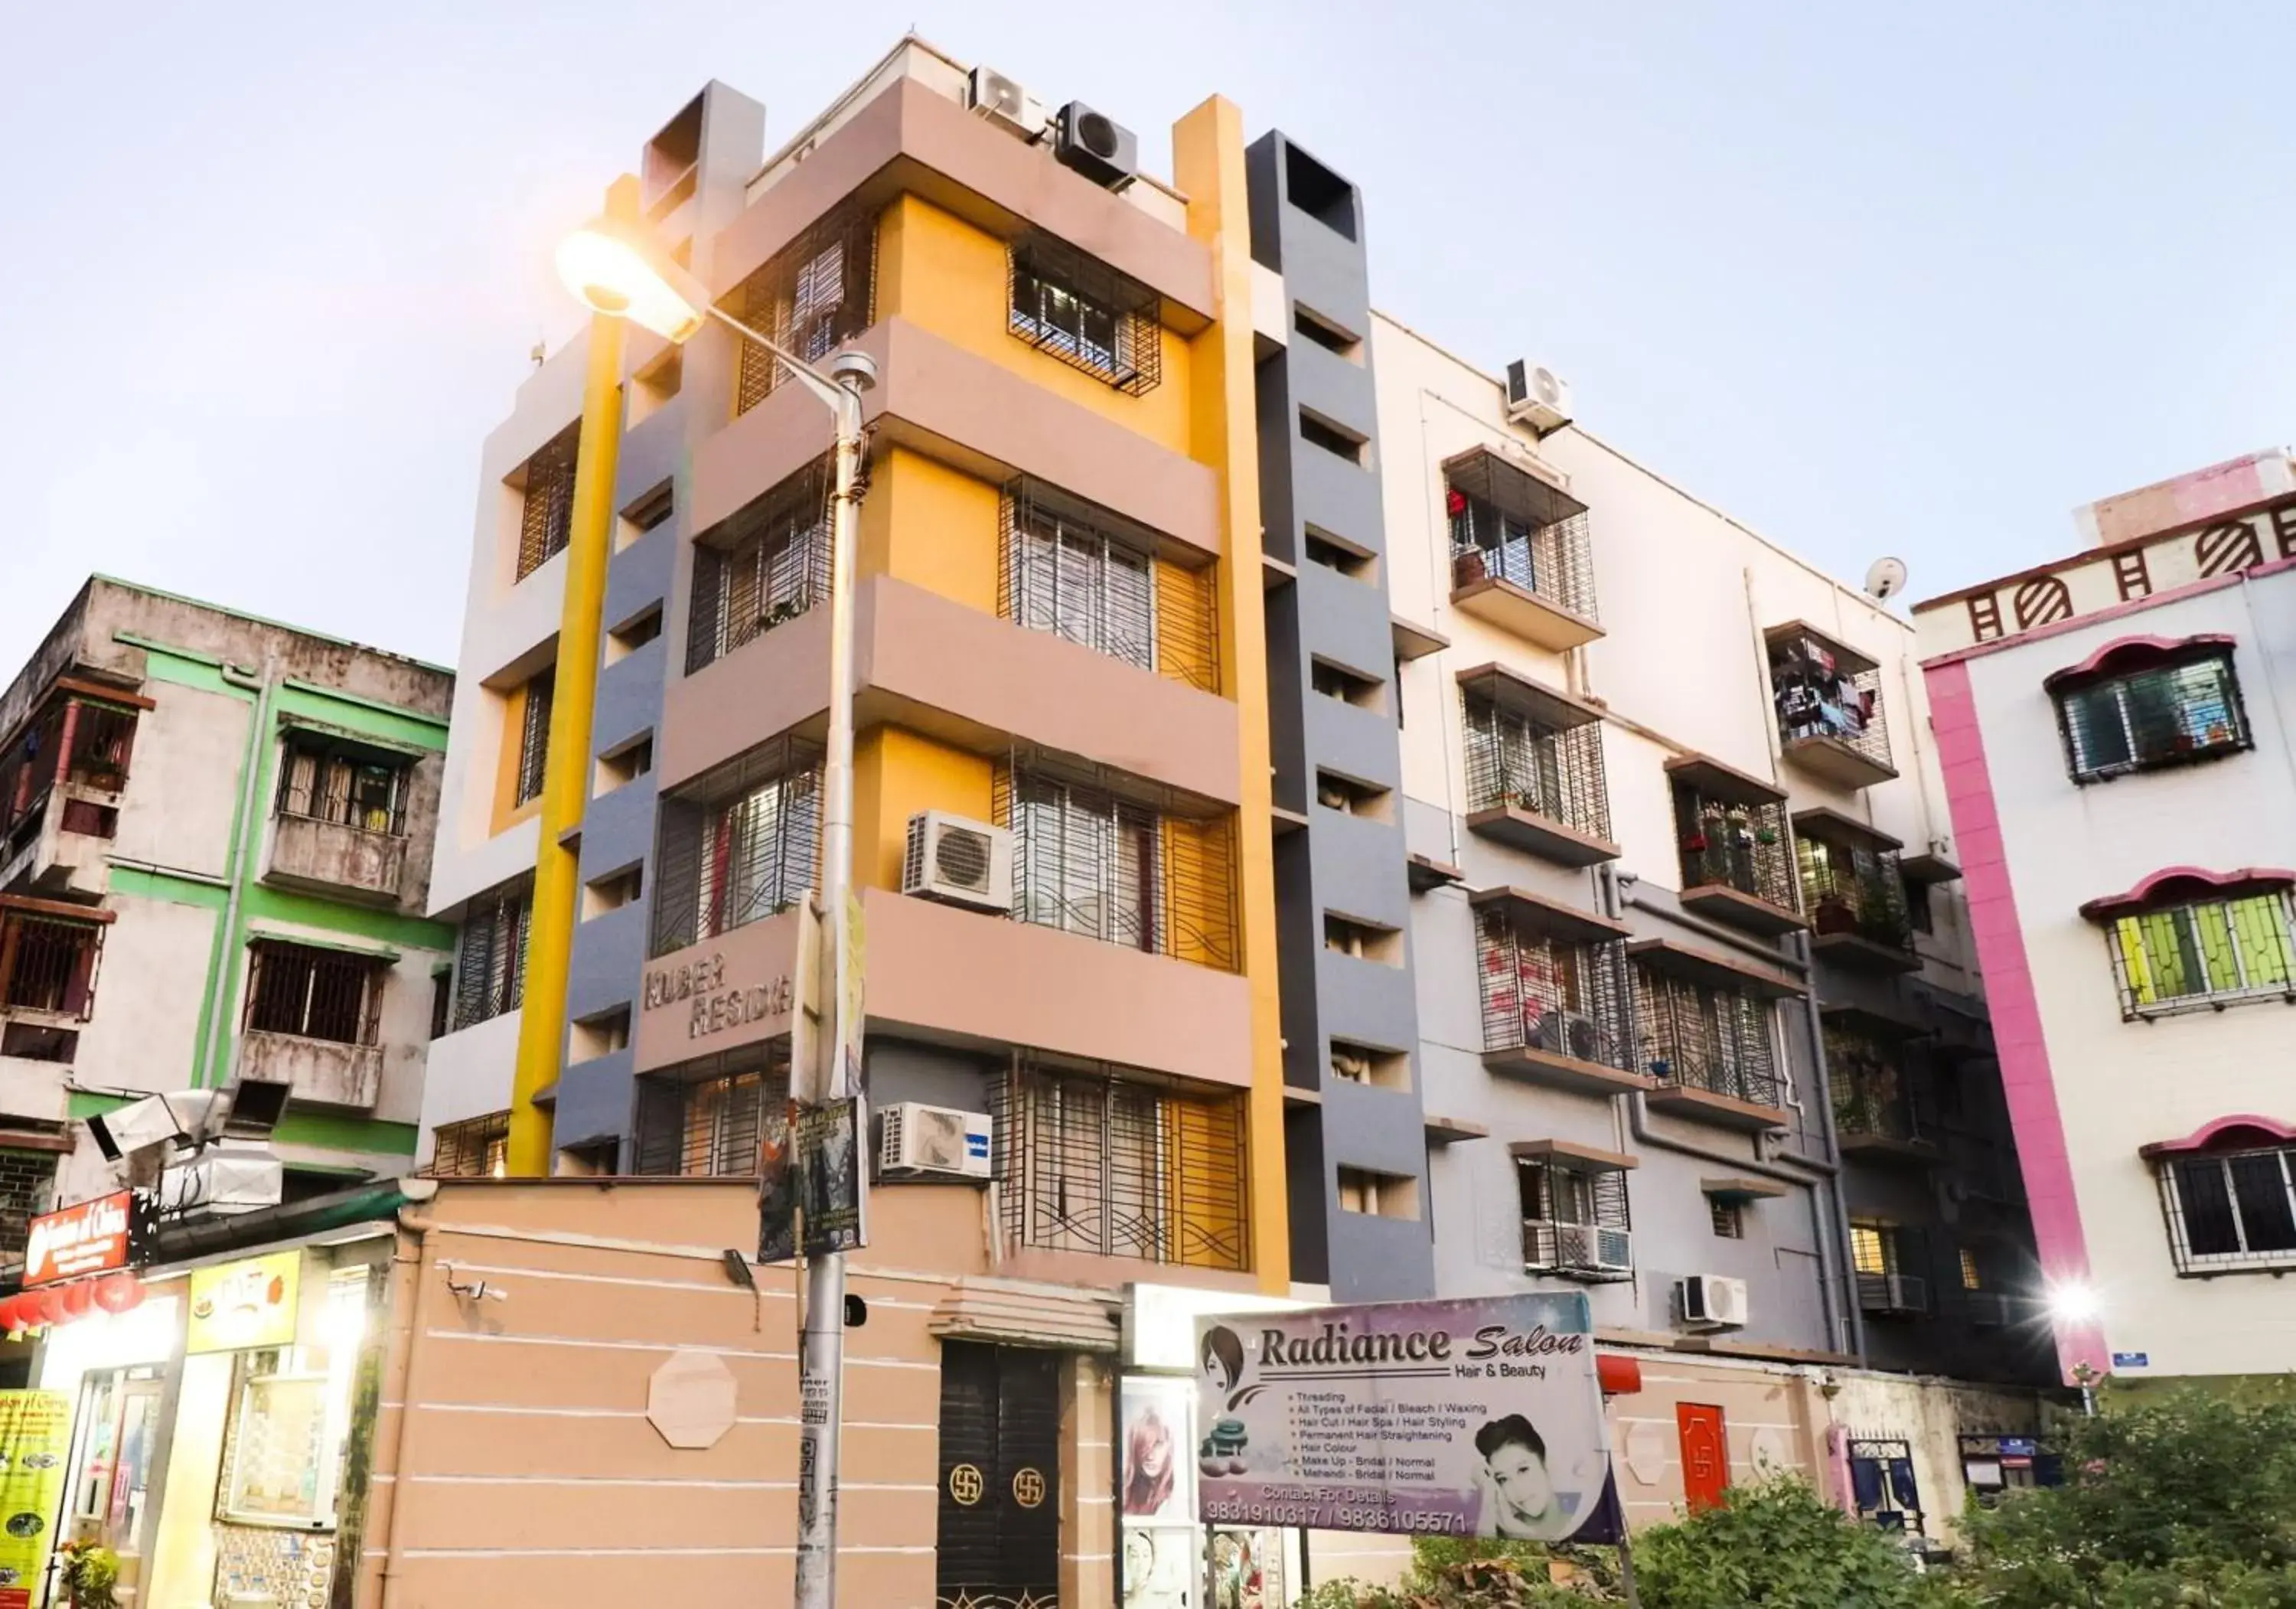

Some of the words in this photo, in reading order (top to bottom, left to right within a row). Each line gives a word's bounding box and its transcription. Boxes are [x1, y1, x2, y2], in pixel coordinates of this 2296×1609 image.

[644, 953, 726, 1010] KUBER
[690, 974, 795, 1039] RESIDE
[1258, 1323, 1451, 1366] Radiance
[1466, 1324, 1583, 1359] Salon
[1455, 1364, 1482, 1378] Hair
[1486, 1363, 1496, 1377] &
[1500, 1363, 1545, 1381] Beauty
[1296, 1392, 1345, 1403] Threading
[1297, 1405, 1309, 1414] All
[1313, 1405, 1342, 1416] Types
[1345, 1404, 1355, 1414] of
[1357, 1404, 1388, 1414] Facial
[1397, 1403, 1435, 1414] Bleach
[1444, 1403, 1487, 1415] Waxing
[1299, 1418, 1317, 1427] Hair
[1320, 1417, 1339, 1427] Cut
[1348, 1418, 1368, 1427] Hair
[1372, 1417, 1393, 1428] Spa
[1403, 1417, 1425, 1427] Hair
[1428, 1417, 1466, 1429] Styling
[1300, 1430, 1354, 1440] Permanent
[1356, 1431, 1377, 1439] Hair
[1381, 1431, 1453, 1443] Straightening
[1301, 1443, 1320, 1452] Hair
[1323, 1442, 1357, 1453] Colour
[1302, 1456, 1329, 1465] Make
[1331, 1456, 1346, 1467] Up
[1355, 1456, 1386, 1466] Bridal
[1395, 1457, 1435, 1467] Normal
[1355, 1469, 1386, 1479] Bridal
[1395, 1470, 1435, 1480] Normal
[1263, 1484, 1315, 1502] Contact
[1318, 1487, 1341, 1502] For
[1345, 1487, 1396, 1505] Details
[1207, 1500, 1320, 1526] 9831910317
[1340, 1506, 1466, 1532] 9836105571
